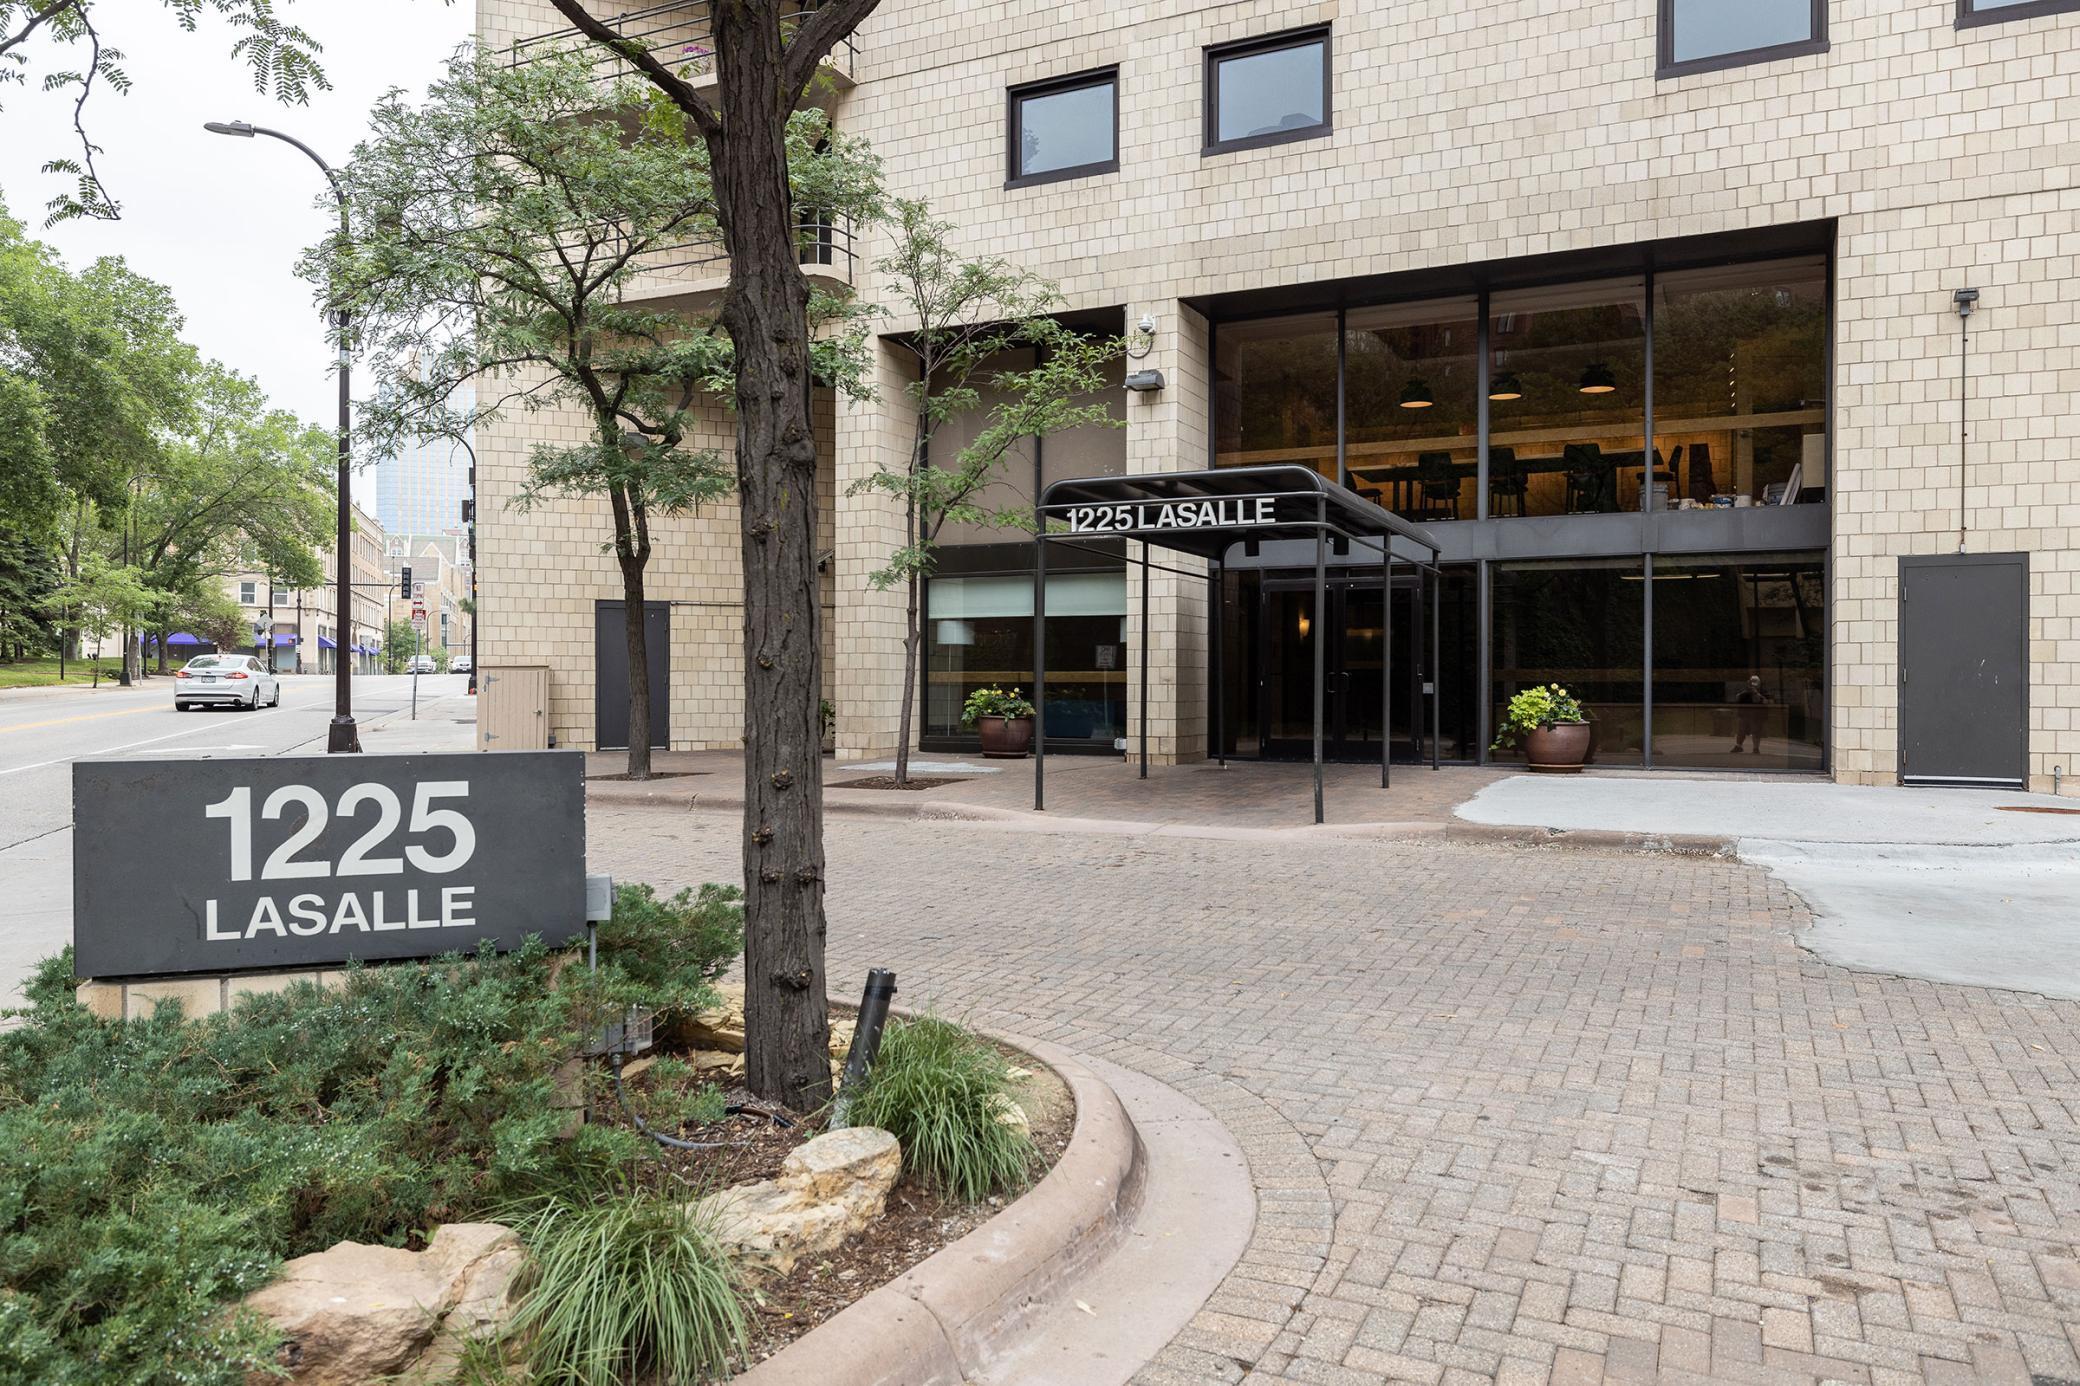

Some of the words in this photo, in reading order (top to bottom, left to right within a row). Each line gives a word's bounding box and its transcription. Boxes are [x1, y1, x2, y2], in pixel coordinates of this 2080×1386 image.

[1066, 505, 1134, 533] 1225
[1137, 497, 1276, 530] LASALLE
[205, 780, 476, 882] 1225
[205, 885, 476, 941] LASALLE
